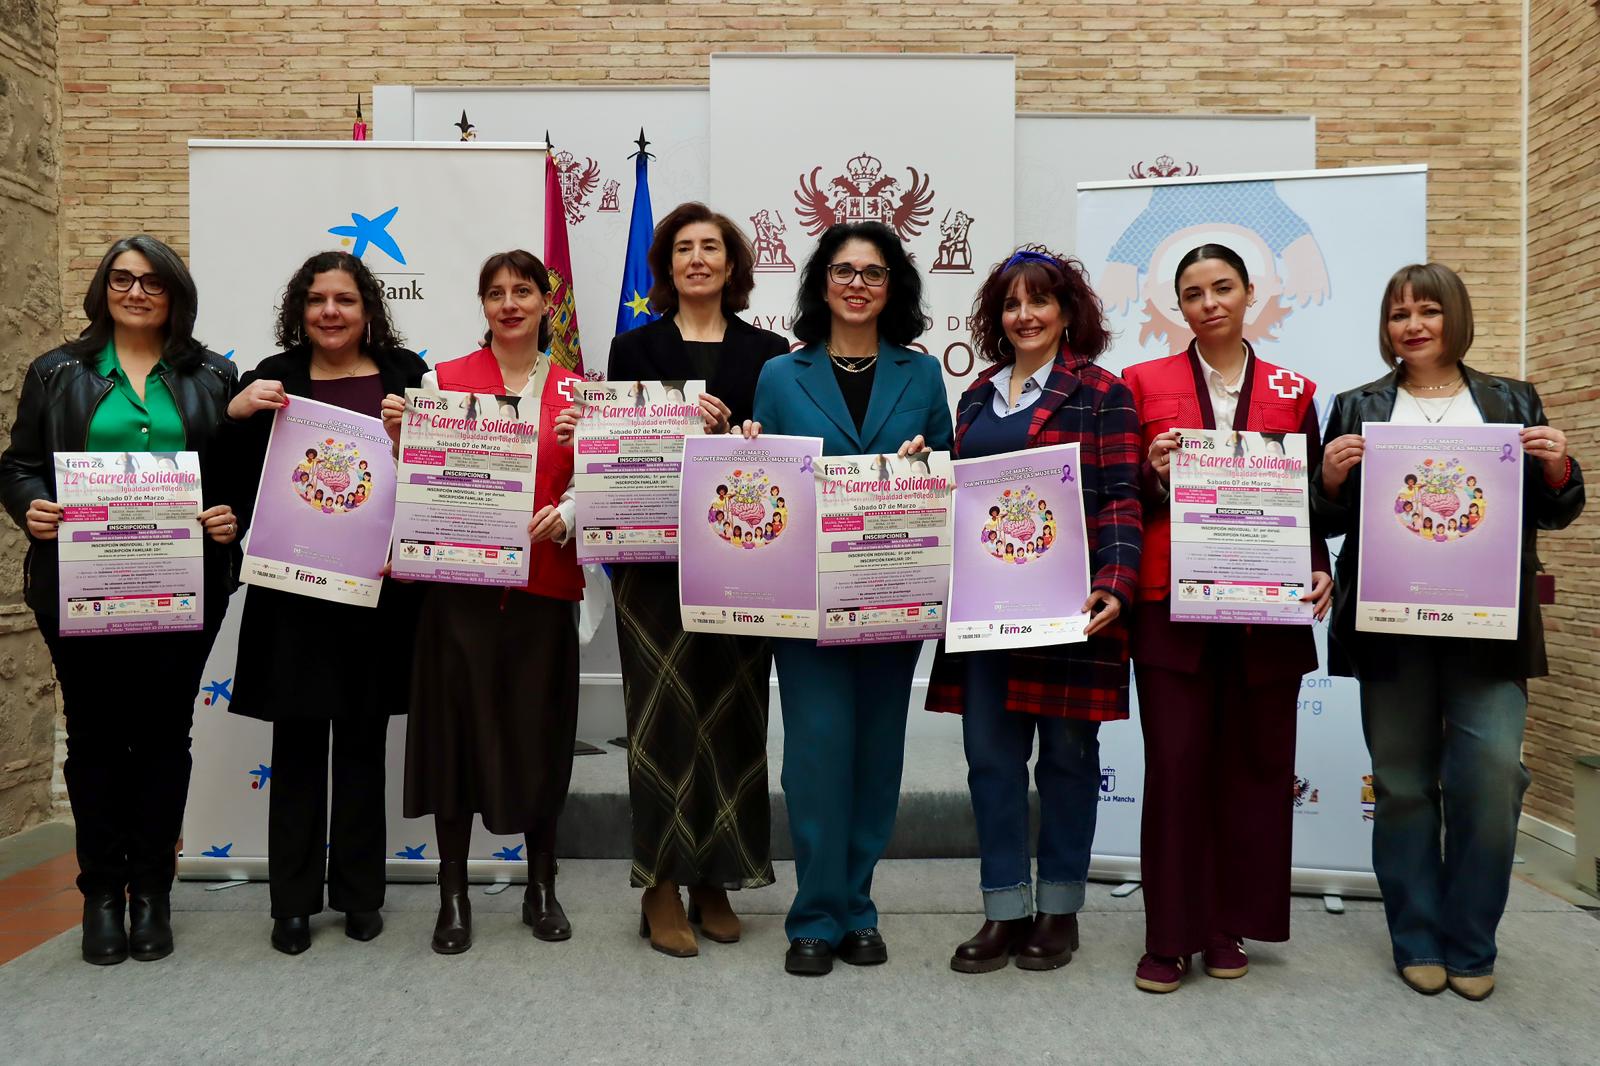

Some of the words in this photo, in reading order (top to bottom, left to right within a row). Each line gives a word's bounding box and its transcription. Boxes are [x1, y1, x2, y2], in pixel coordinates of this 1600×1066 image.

[603, 403, 647, 420] Carrera
[650, 401, 702, 419] Solidaria
[296, 418, 343, 433] INTERNACIONAL
[432, 414, 478, 431] Carrera
[480, 418, 535, 436] Solidaria
[632, 418, 658, 427] Igualdad
[343, 423, 364, 432] MARZO
[460, 432, 488, 441] Igualdad
[620, 456, 661, 464] INSCRIPCIONES
[1200, 454, 1245, 468] Carrera
[1248, 456, 1303, 470] Solidaria
[1014, 466, 1033, 474] MARZO
[89, 469, 137, 486] Carrera
[140, 469, 196, 486] Solidaria
[445, 471, 489, 479] INSCRIPCIONES
[975, 475, 1015, 487] INTERNACIONAL
[1035, 468, 1062, 477] MUJERES
[846, 476, 891, 495] Carrera
[894, 473, 947, 493] Solidaria
[121, 485, 150, 494] Igualdad
[876, 492, 903, 502] Igualdad
[913, 492, 934, 500] Toledo
[109, 523, 155, 531] INSCRIPCIONES
[864, 532, 907, 541] INSCRIPCIONES
